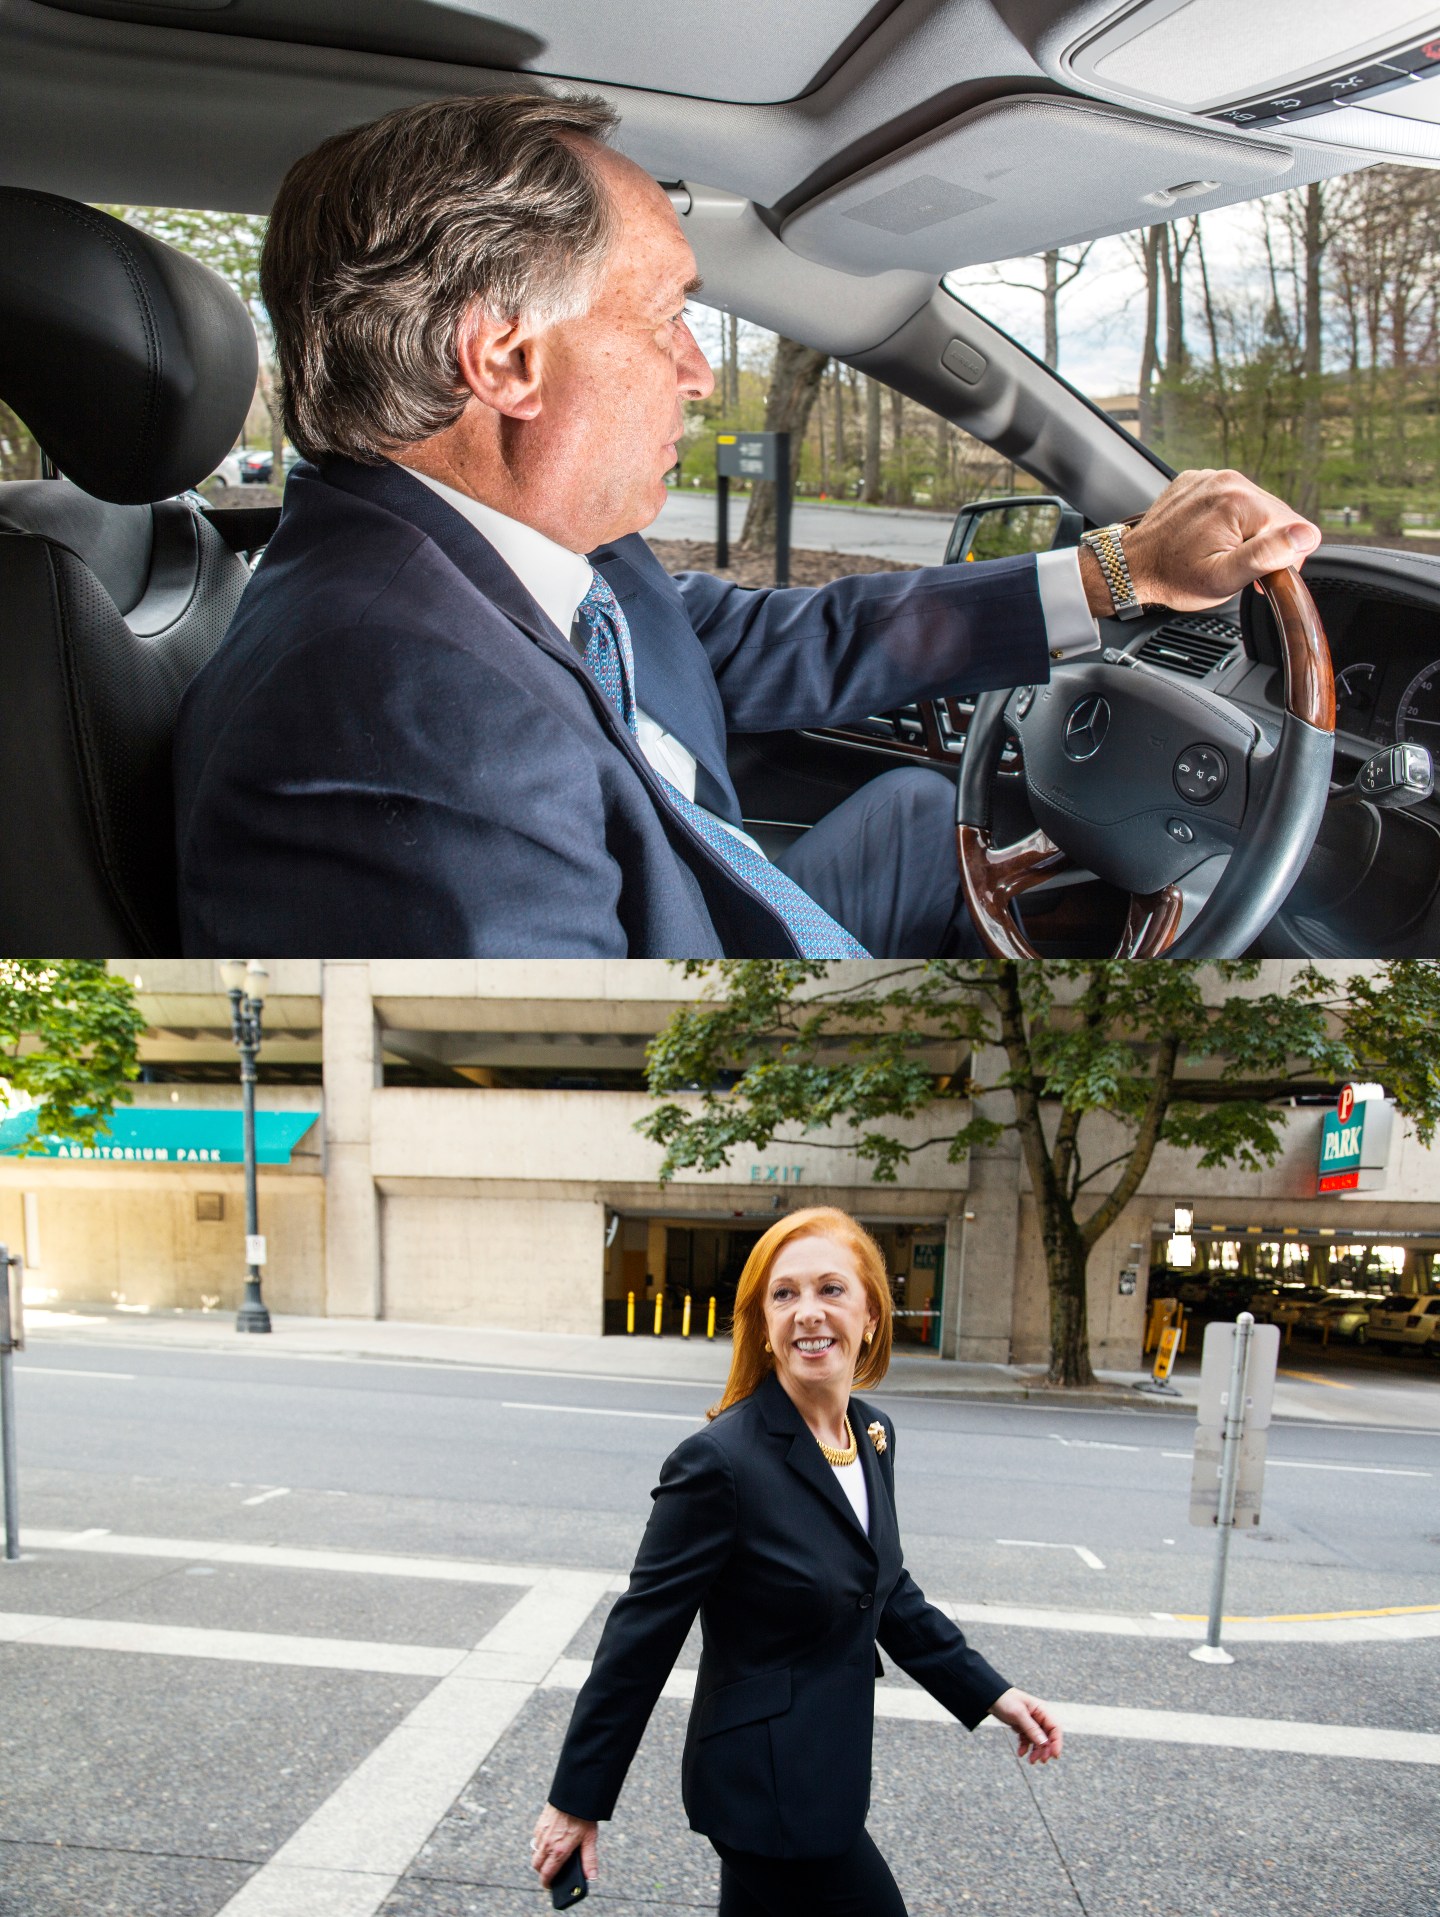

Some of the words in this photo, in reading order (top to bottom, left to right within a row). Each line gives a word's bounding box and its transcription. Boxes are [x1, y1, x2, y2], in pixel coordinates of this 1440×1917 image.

[1421, 682, 1433, 691] 40
[1407, 705, 1419, 716] 20
[1340, 1089, 1353, 1119] P
[1323, 1126, 1362, 1160] PARK
[58, 1145, 169, 1161] AUDITORIUM
[176, 1148, 221, 1162] PARK
[751, 1164, 804, 1183] EXIT
